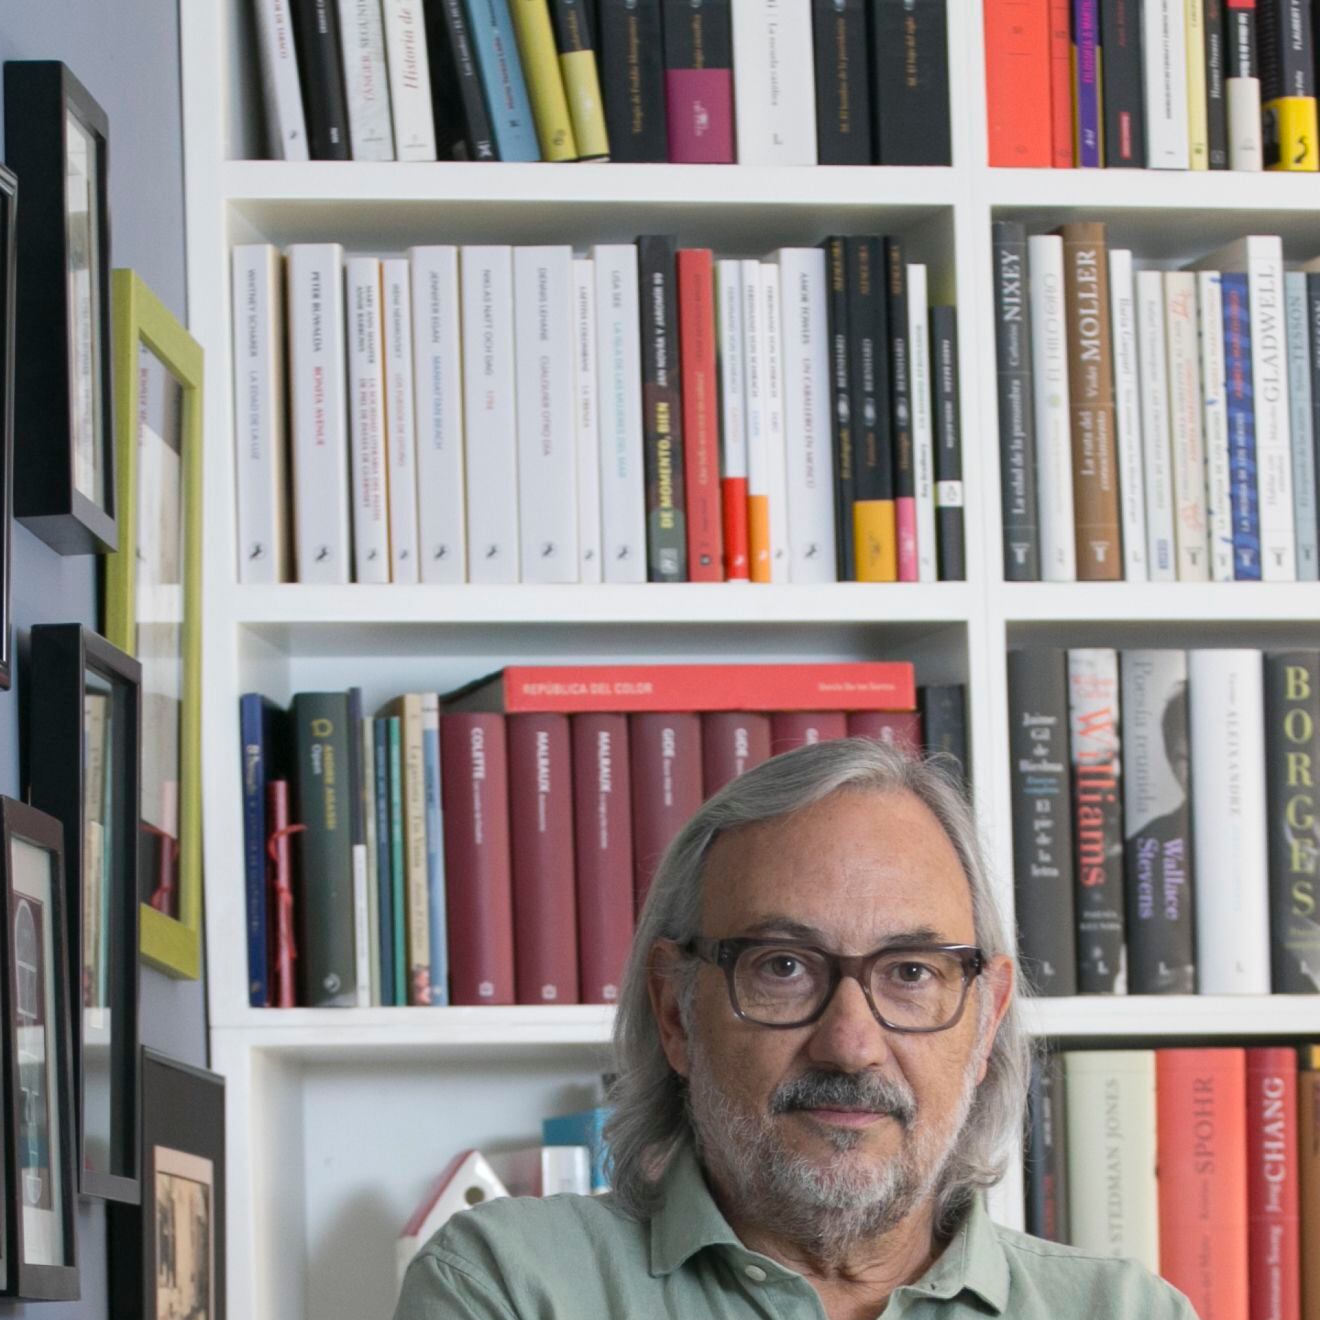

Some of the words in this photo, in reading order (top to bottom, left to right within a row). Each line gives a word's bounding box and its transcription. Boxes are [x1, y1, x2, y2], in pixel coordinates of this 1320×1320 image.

[403, 30, 419, 90] Historia
[246, 269, 258, 313] WHITNEY
[310, 271, 322, 300] PETER
[429, 270, 441, 315] JENNIFER
[481, 269, 493, 303] NIKLAS
[537, 267, 549, 304] DENNIS
[1001, 249, 1023, 323] NIXEY
[1076, 249, 1102, 361] MOLLER
[482, 305, 494, 330] NATT
[1256, 264, 1280, 403] GLADWELL
[1286, 294, 1305, 361] TESSON
[313, 366, 325, 406] BONITA
[431, 355, 444, 417] MANHATTAN
[539, 355, 552, 409] CUALQUIER
[314, 407, 326, 447] AVENUE
[540, 410, 553, 437] OTRO
[655, 401, 671, 433] BIEN
[1009, 378, 1026, 435] penumbra
[432, 418, 445, 451] BEACH
[657, 434, 674, 507] MOMENTO,
[1011, 462, 1026, 497] edad
[659, 510, 674, 529] DE
[1011, 498, 1027, 515] La
[521, 680, 586, 696] REPÚBLICA
[590, 681, 612, 696] DEL
[614, 680, 653, 696] COLOR
[1132, 659, 1155, 727] Poesía
[309, 743, 323, 775] Open
[322, 743, 336, 786] ANDRE
[408, 744, 421, 761] La
[469, 726, 485, 781] COLETTE
[535, 731, 551, 793] MALRAUX
[596, 731, 612, 793] MALRAUX
[660, 727, 677, 760] GIDE
[732, 726, 749, 760] GIDE
[1019, 757, 1064, 773] Biedma
[1226, 708, 1242, 816] ALEIXANDRE
[408, 762, 423, 803] gaviota
[1074, 705, 1118, 887] Williams
[1133, 734, 1156, 815] reunida
[1282, 665, 1318, 918] BORGES
[324, 787, 338, 831] AGASSI
[410, 815, 423, 834] Tío
[412, 836, 424, 868] Vania
[1137, 837, 1159, 919] Stevens
[1162, 837, 1185, 921] Wallace
[1103, 1078, 1125, 1142] JONES
[1191, 1076, 1215, 1176] SPOHR
[1262, 1076, 1287, 1183] CHANG
[1106, 1145, 1125, 1243] STEDMAN
